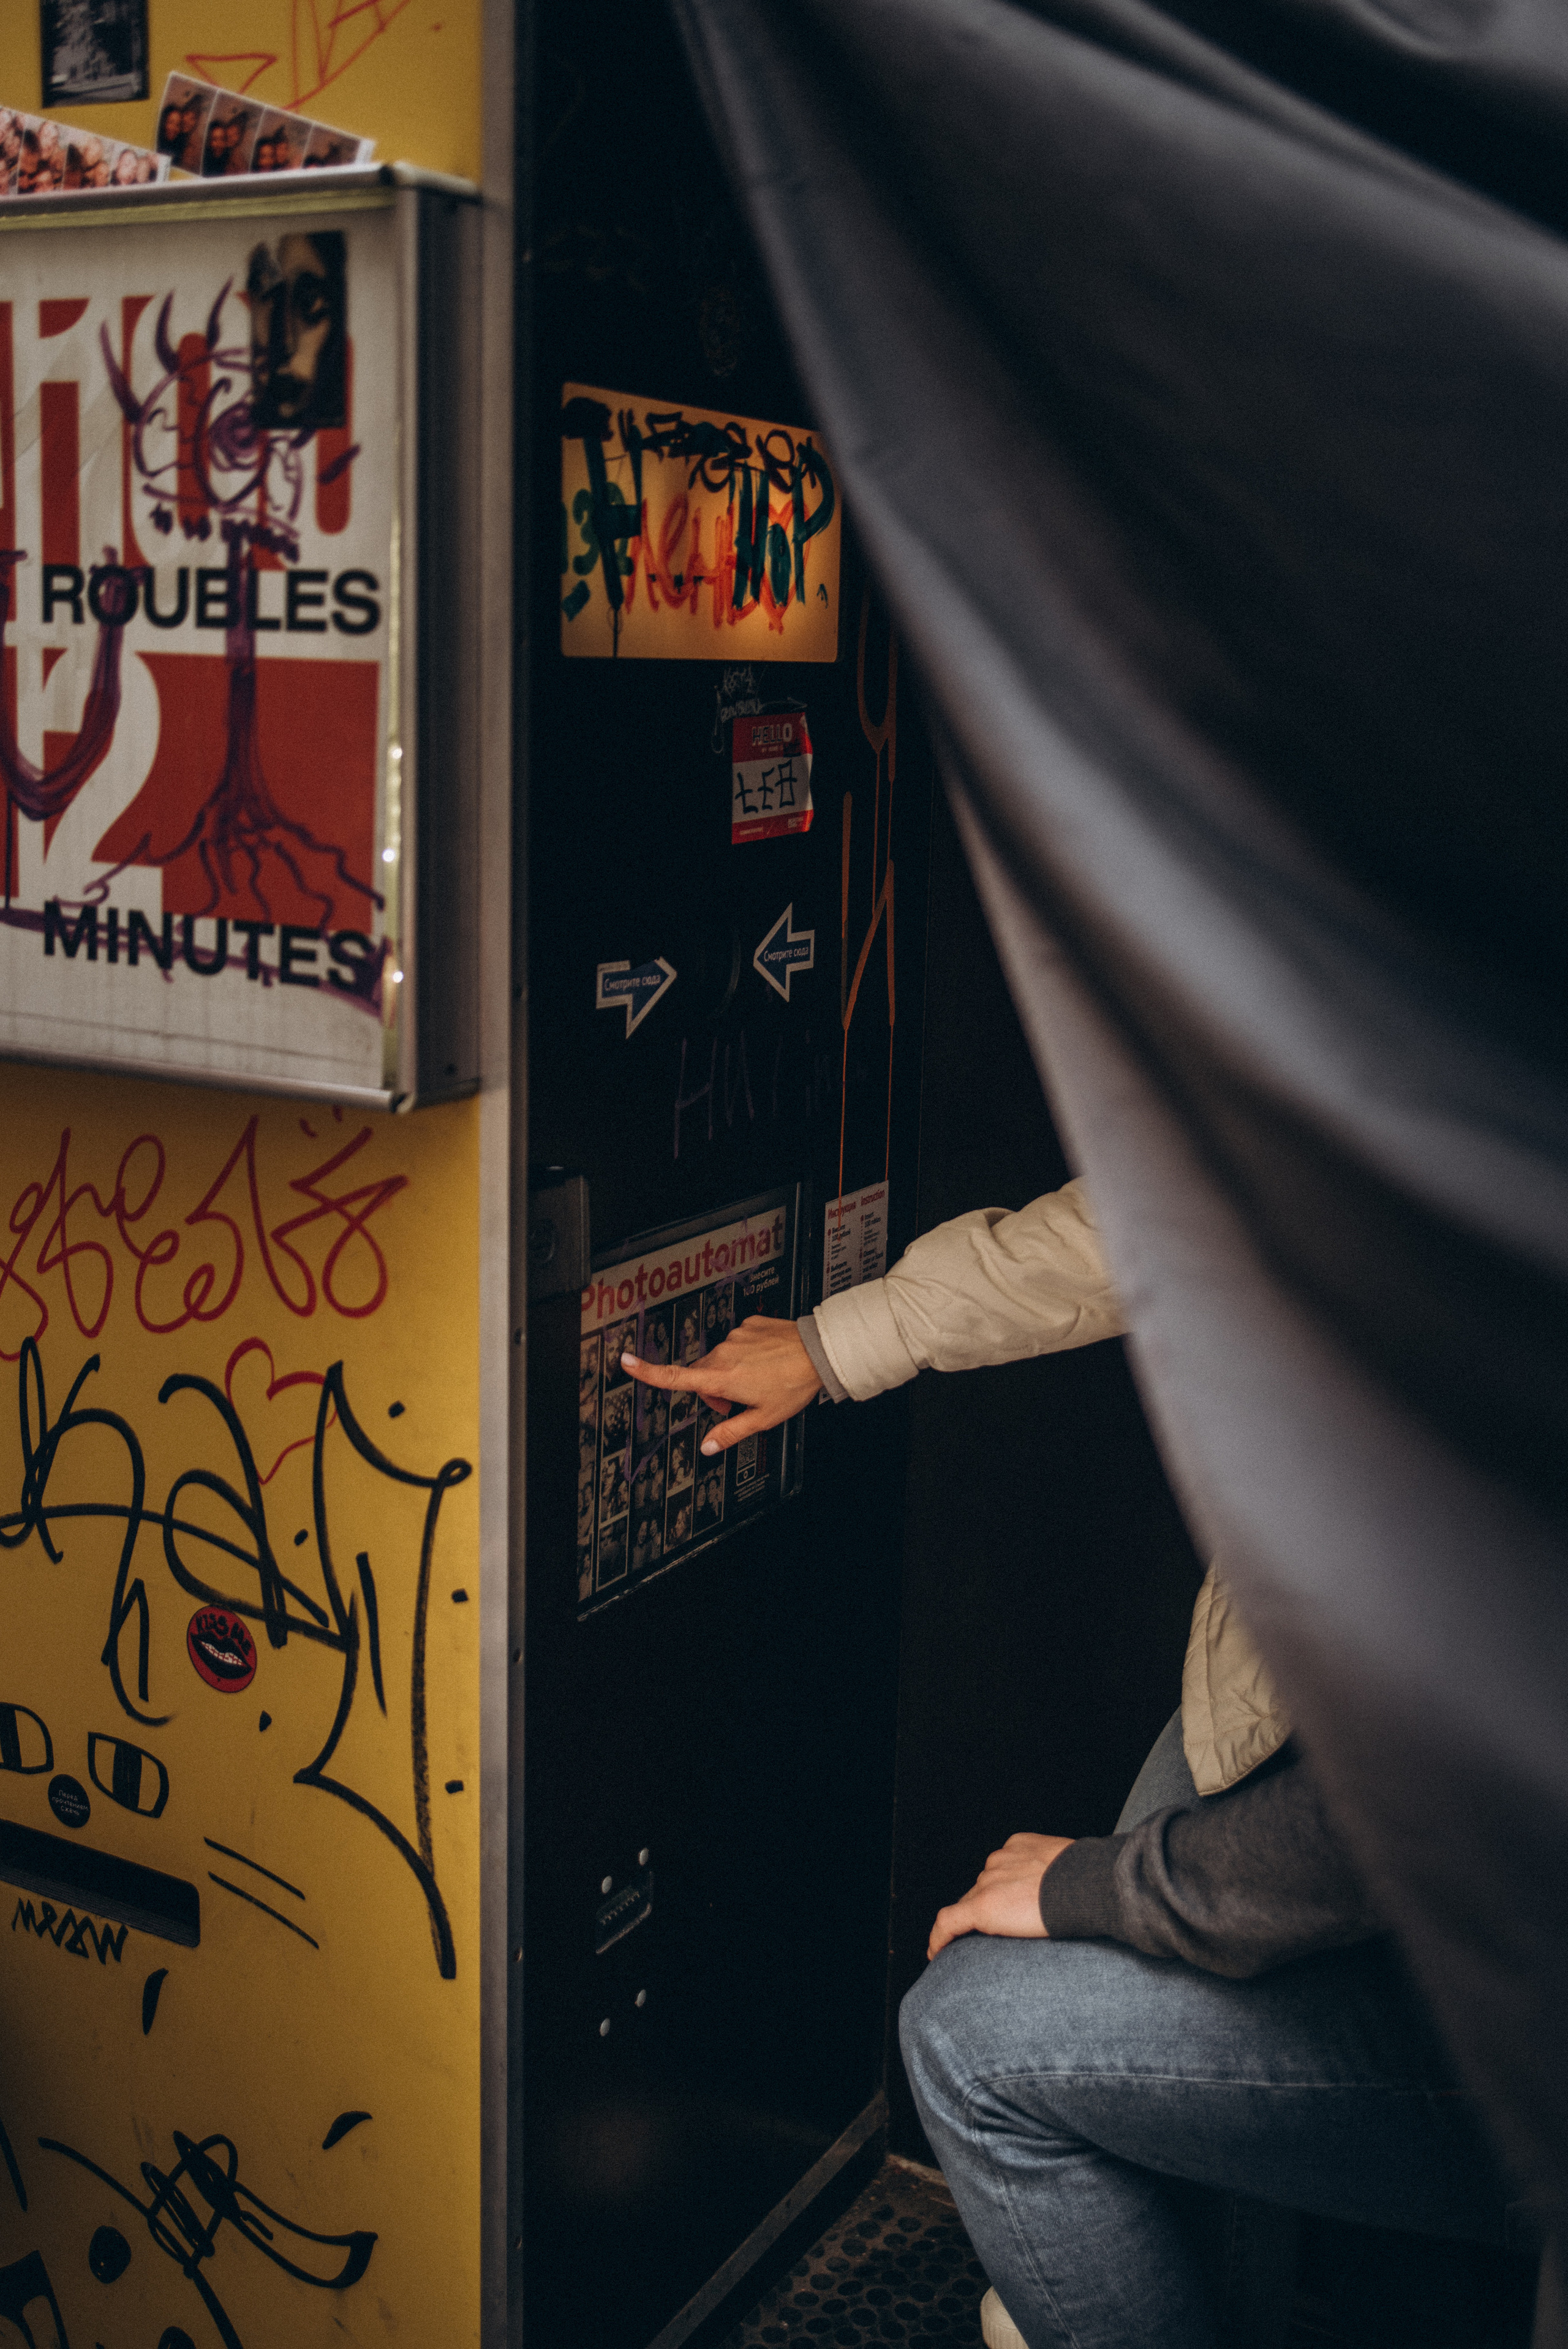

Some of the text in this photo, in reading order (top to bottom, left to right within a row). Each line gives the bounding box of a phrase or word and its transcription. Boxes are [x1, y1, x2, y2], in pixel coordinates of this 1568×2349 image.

[42, 564, 381, 635] ROUBLES
[752, 723, 793, 746] HELLO
[43, 901, 376, 993] MINUTES
[763, 946, 809, 963] Смотрите сюда
[603, 973, 662, 992] Смотрите сюда
[861, 1189, 885, 1206] Instruction
[756, 1274, 779, 1293] рублей
[59, 1790, 78, 1801] Перед
